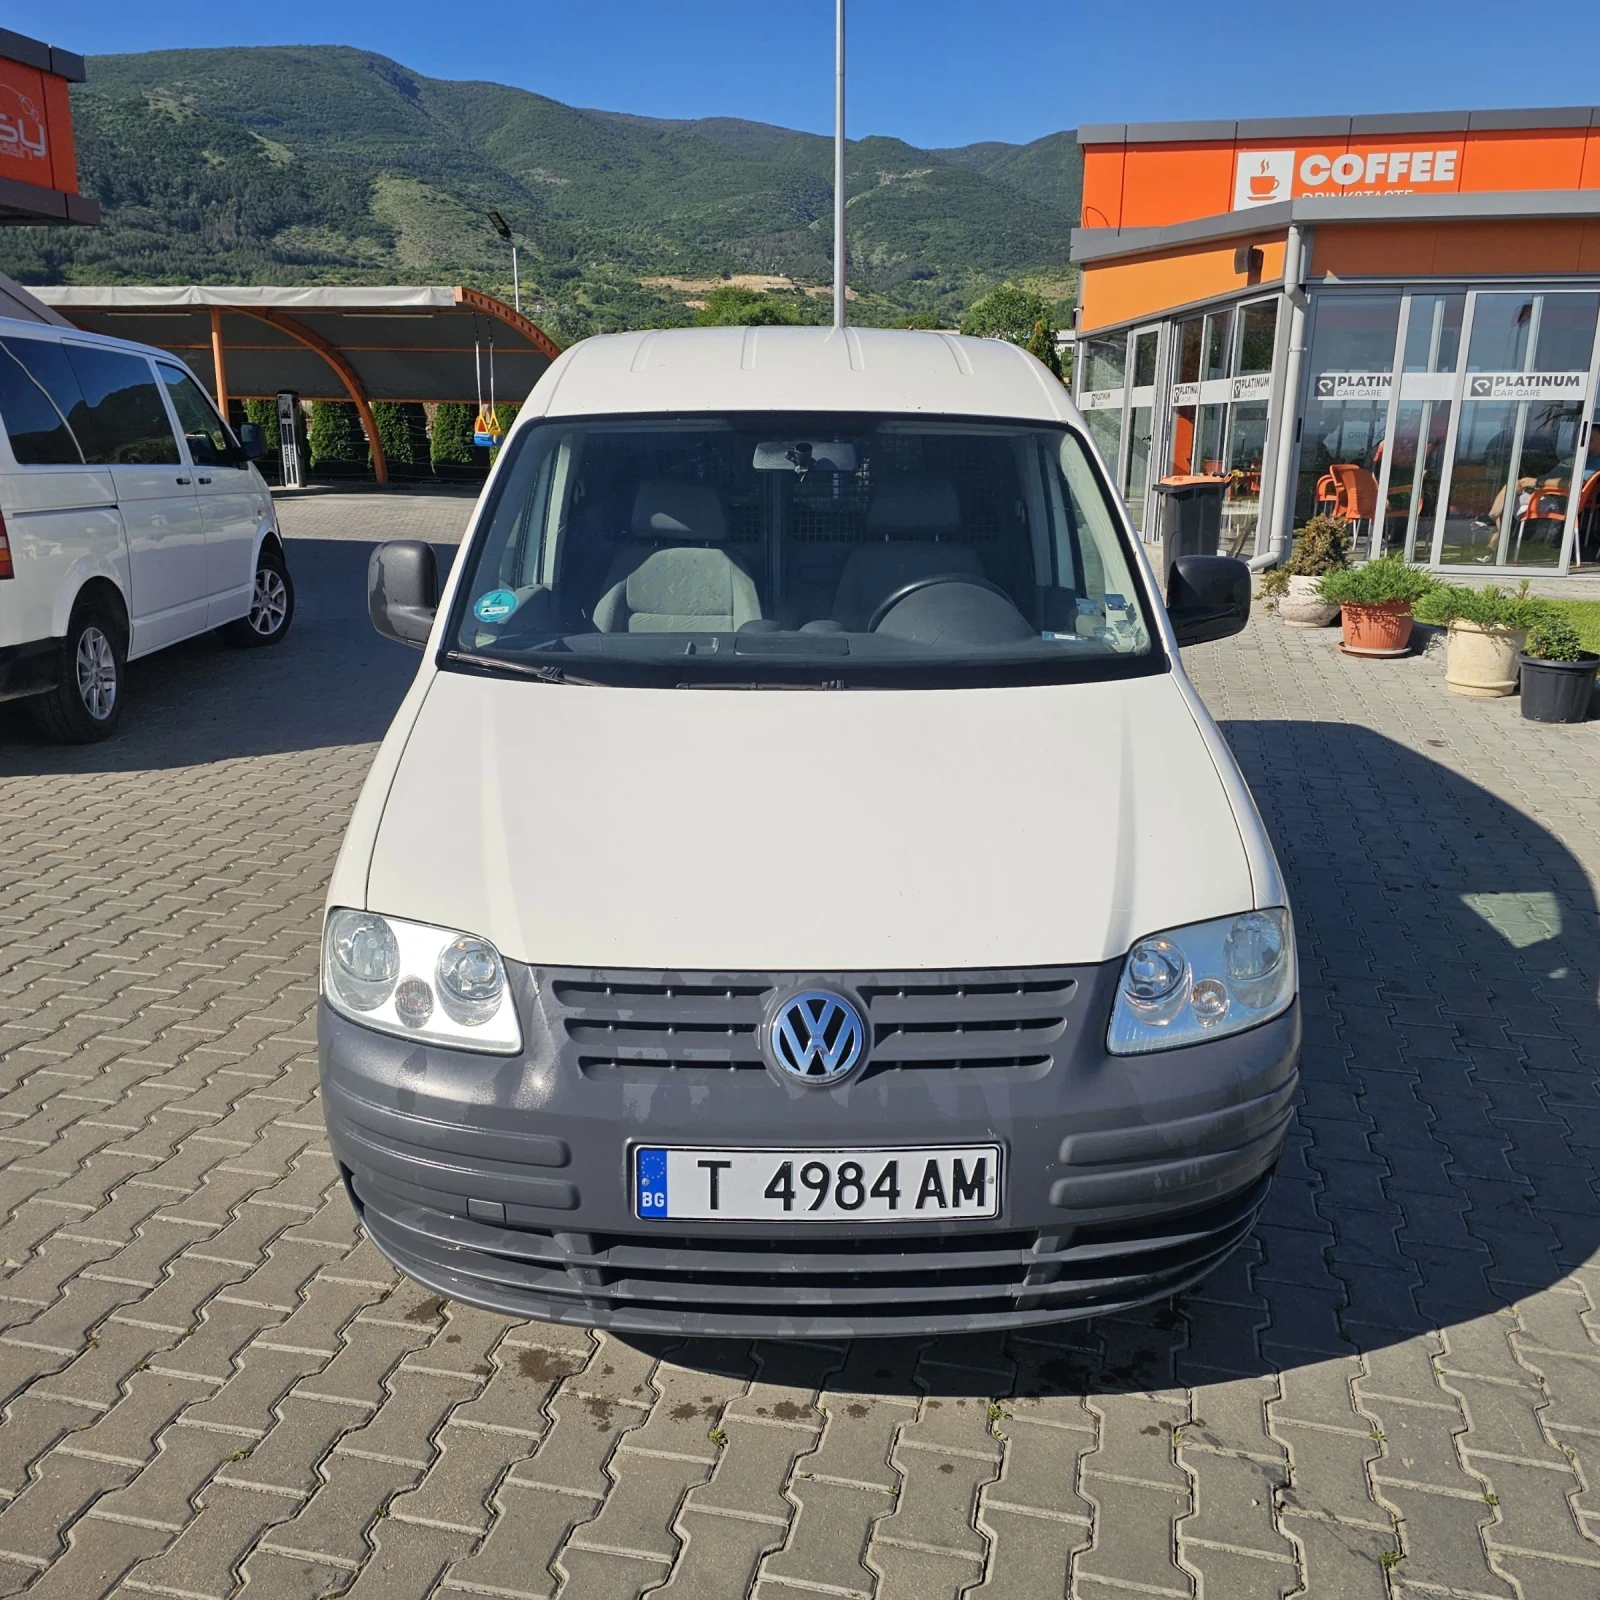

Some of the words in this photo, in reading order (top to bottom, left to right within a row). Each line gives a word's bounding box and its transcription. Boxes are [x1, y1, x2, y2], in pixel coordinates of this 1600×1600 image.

[1300, 151, 1457, 185] COFFEE
[1240, 376, 1270, 389] PLATINUM
[1495, 376, 1580, 387] PLATINUM
[1336, 389, 1355, 397] CAR
[1357, 389, 1381, 397] CARE
[1493, 389, 1513, 397] CAR
[1515, 389, 1541, 397] CARE
[697, 1160, 731, 1210] T
[764, 1161, 901, 1211] 4984
[915, 1157, 986, 1209] AM
[642, 1192, 665, 1208] BG
